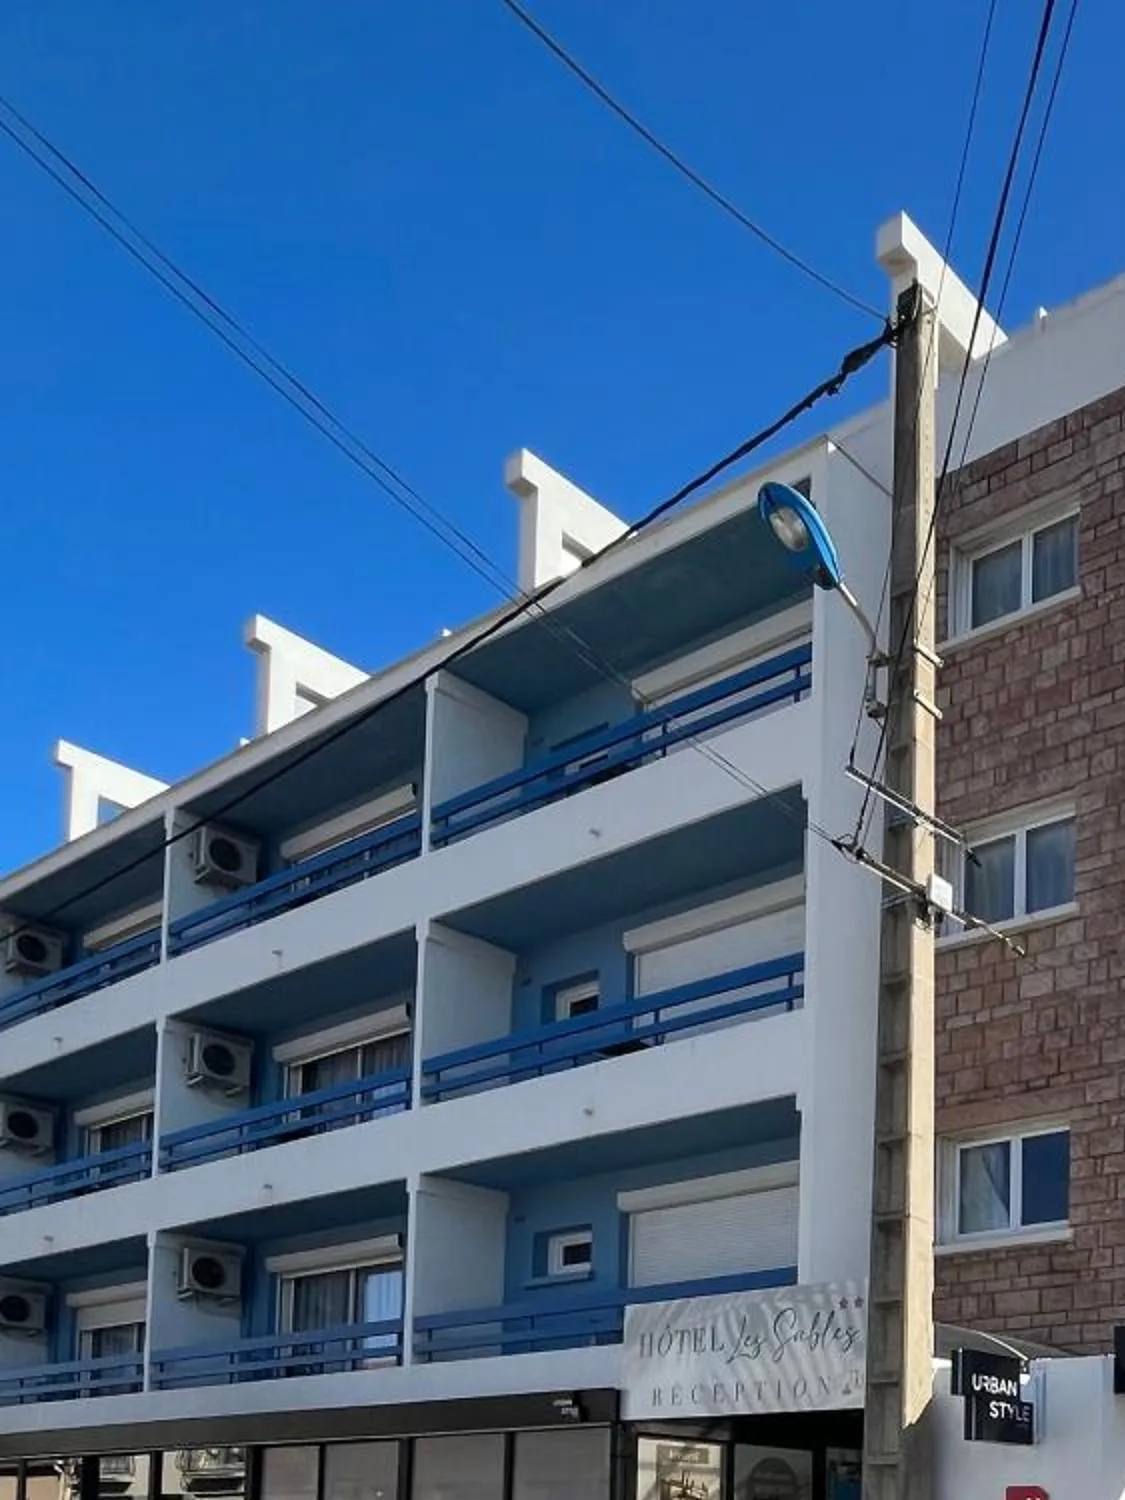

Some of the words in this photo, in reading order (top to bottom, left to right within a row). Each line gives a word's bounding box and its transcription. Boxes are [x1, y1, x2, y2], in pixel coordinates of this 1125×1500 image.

[726, 1314, 767, 1364] Les
[772, 1307, 861, 1363] Sables
[971, 1373, 1017, 1397] URBAN
[989, 1400, 1031, 1422] STYLE
